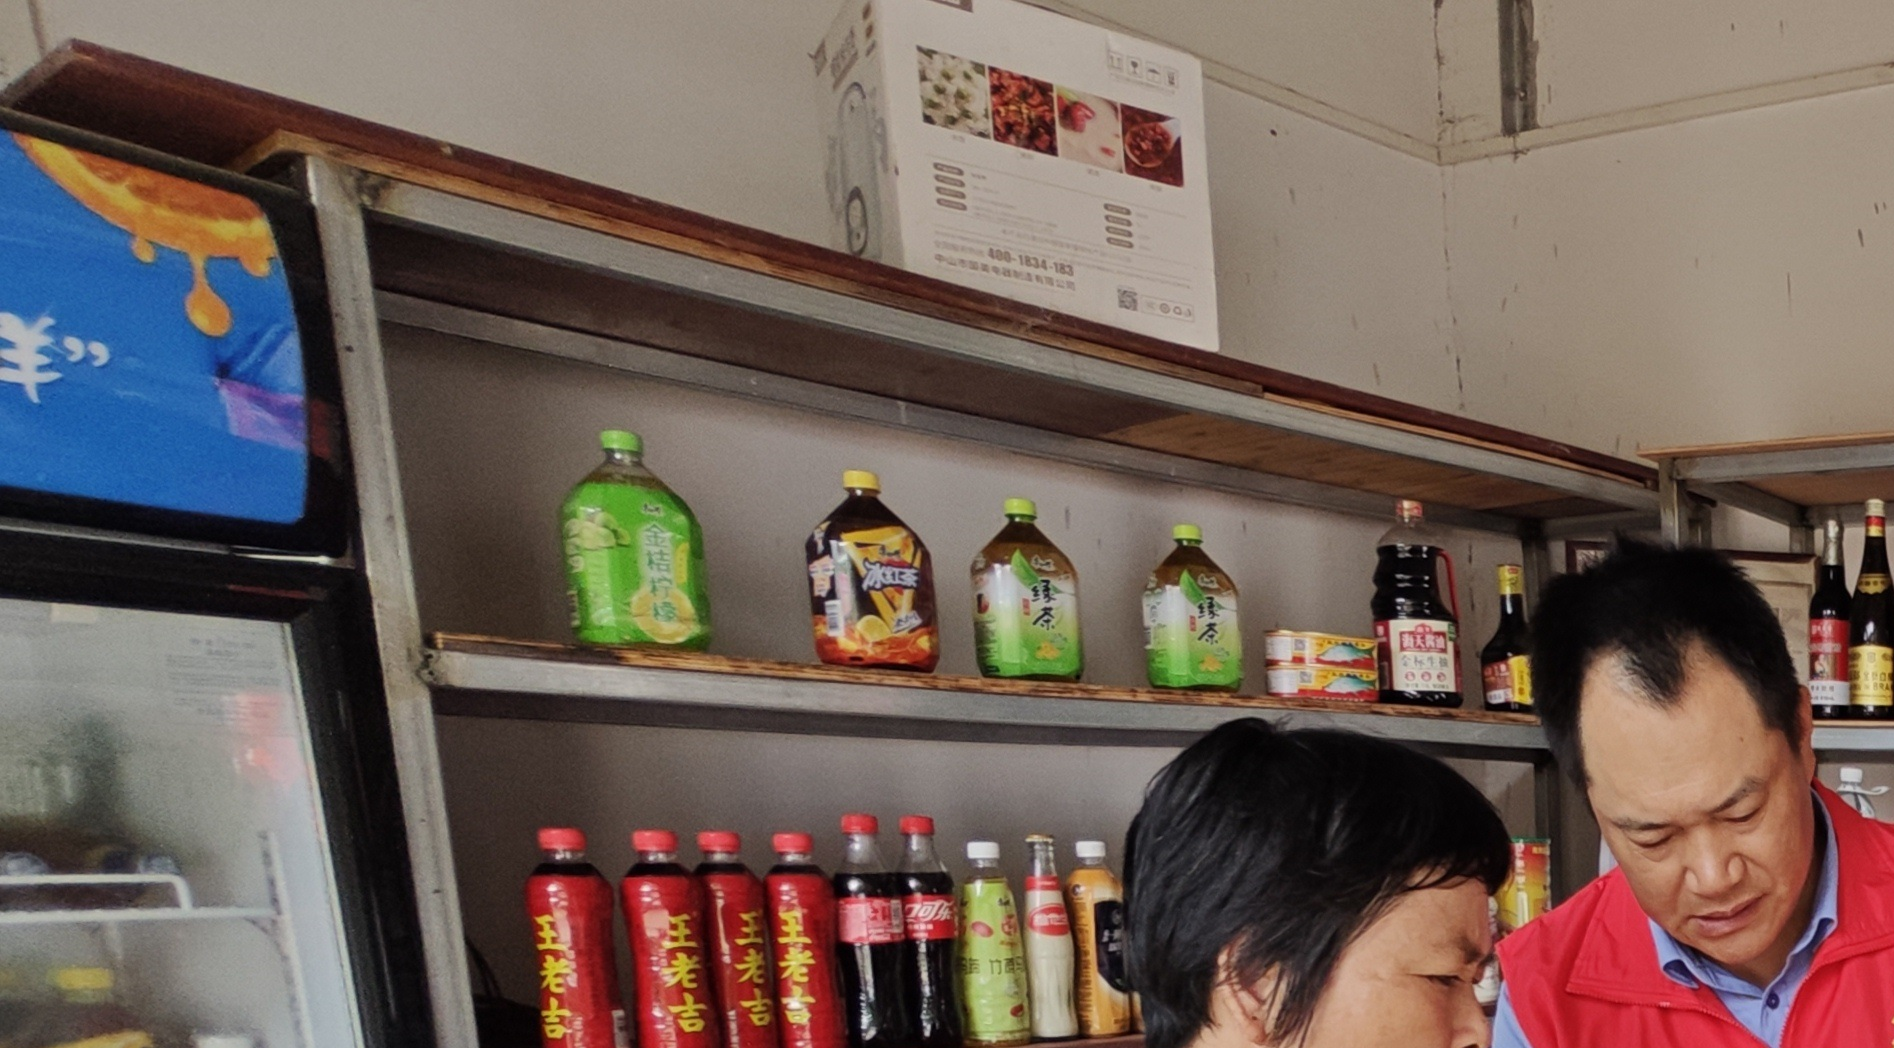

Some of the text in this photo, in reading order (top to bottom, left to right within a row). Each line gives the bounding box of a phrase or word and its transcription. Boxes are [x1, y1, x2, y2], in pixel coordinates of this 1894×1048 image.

[534, 914, 573, 1039] 王老吉
[662, 914, 708, 1032] 王老吉
[734, 911, 773, 1026] 王老吉
[778, 909, 816, 1024] 王老吉
